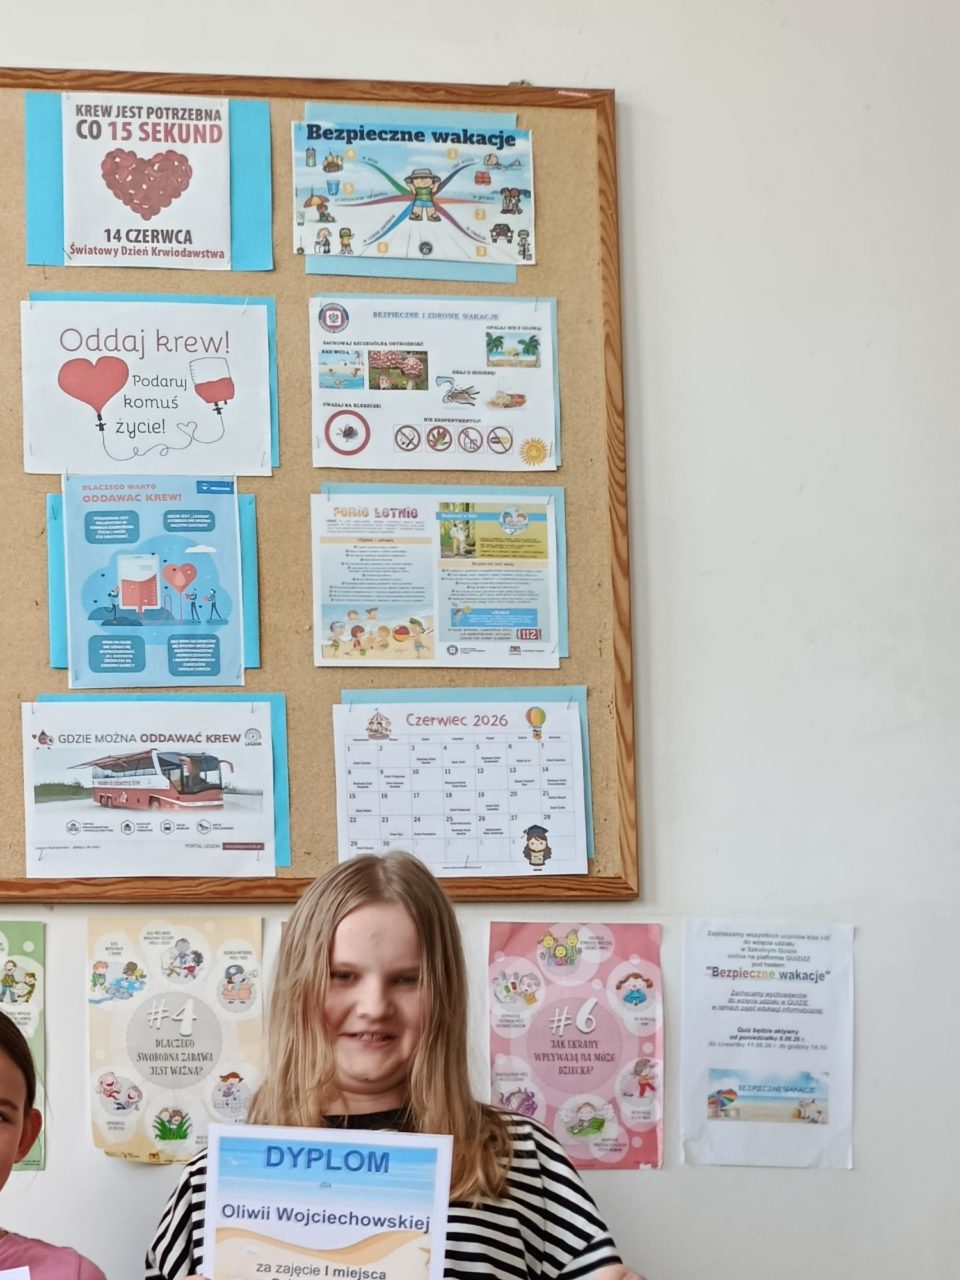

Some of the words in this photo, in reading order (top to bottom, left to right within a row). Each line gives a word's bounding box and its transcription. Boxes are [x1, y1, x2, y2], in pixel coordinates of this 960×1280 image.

[76, 104, 112, 118] KREW
[115, 106, 143, 119] JEST
[147, 107, 221, 121] POTRZEBNA
[76, 120, 101, 140] CO
[108, 122, 132, 141] 15
[139, 122, 223, 144] SEKUND
[307, 123, 425, 144] Bezpieczne
[432, 131, 516, 150] wakacje
[104, 229, 122, 243] 14
[126, 229, 192, 245] CZERWCA
[70, 242, 119, 257] Światowy
[121, 246, 148, 256] Dzień
[151, 247, 224, 259] Krwiodawstwa
[373, 311, 419, 319] BEZPIECZNE
[427, 312, 459, 320] ZDROWE
[463, 312, 499, 321] WAKACJE
[60, 328, 145, 360] Oddaj
[156, 329, 230, 353] krew!
[132, 375, 188, 391] Podaruj
[123, 395, 178, 409] komuś
[115, 418, 166, 439] życie!
[522, 629, 537, 639] 112
[406, 713, 467, 727] Czerwiec
[474, 715, 508, 727] 2026
[58, 734, 92, 744] GDZIE
[95, 732, 136, 743] MOŻNA
[140, 732, 203, 743] ODDAWAĆ
[206, 734, 241, 744] KREW
[707, 966, 775, 980] "Bezpieczne
[779, 970, 831, 983] wakacje"
[146, 998, 197, 1038] #4
[548, 997, 598, 1037] #6
[155, 1039, 195, 1048] DLACZEGO
[551, 1040, 565, 1049] JAK
[568, 1040, 599, 1050] EKRANY
[137, 1052, 179, 1062] SWOBODNA
[182, 1053, 213, 1063] ZABAWA
[534, 1053, 579, 1064] WPŁYWAJĄ
[581, 1054, 592, 1062] NA
[149, 1066, 168, 1076] JEST
[170, 1065, 203, 1076] WAŻNA?
[265, 1145, 391, 1174] DYPLOM
[320, 1181, 332, 1189] dla
[222, 1203, 271, 1221] Oliwii
[277, 1207, 431, 1234] Wojciechowskiej
[256, 1263, 271, 1274] za
[276, 1263, 321, 1277] zajęcie
[333, 1266, 387, 1280] miejsca
